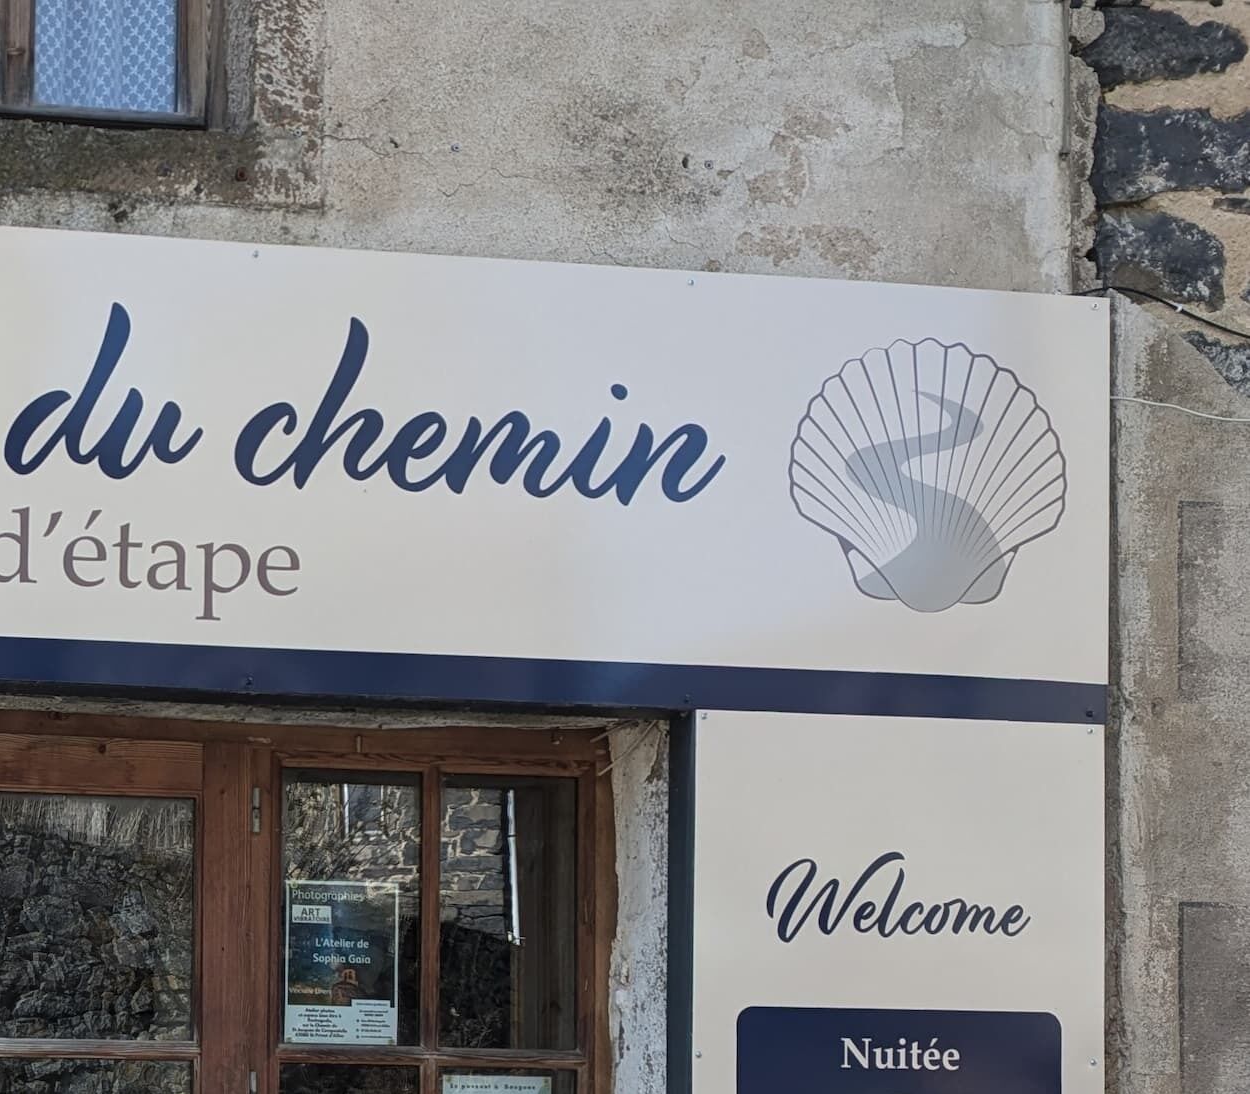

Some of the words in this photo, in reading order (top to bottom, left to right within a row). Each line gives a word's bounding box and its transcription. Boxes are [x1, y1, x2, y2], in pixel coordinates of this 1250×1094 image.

[4, 302, 203, 479] du
[235, 317, 725, 506] chemin
[291, 889, 364, 902] Photographies
[767, 852, 1030, 943] Welcome
[301, 907, 320, 917] ART
[315, 938, 354, 948] L'Atelier
[357, 939, 370, 949] de
[313, 953, 346, 965] Sophia
[841, 1038, 960, 1070] Nuitée
